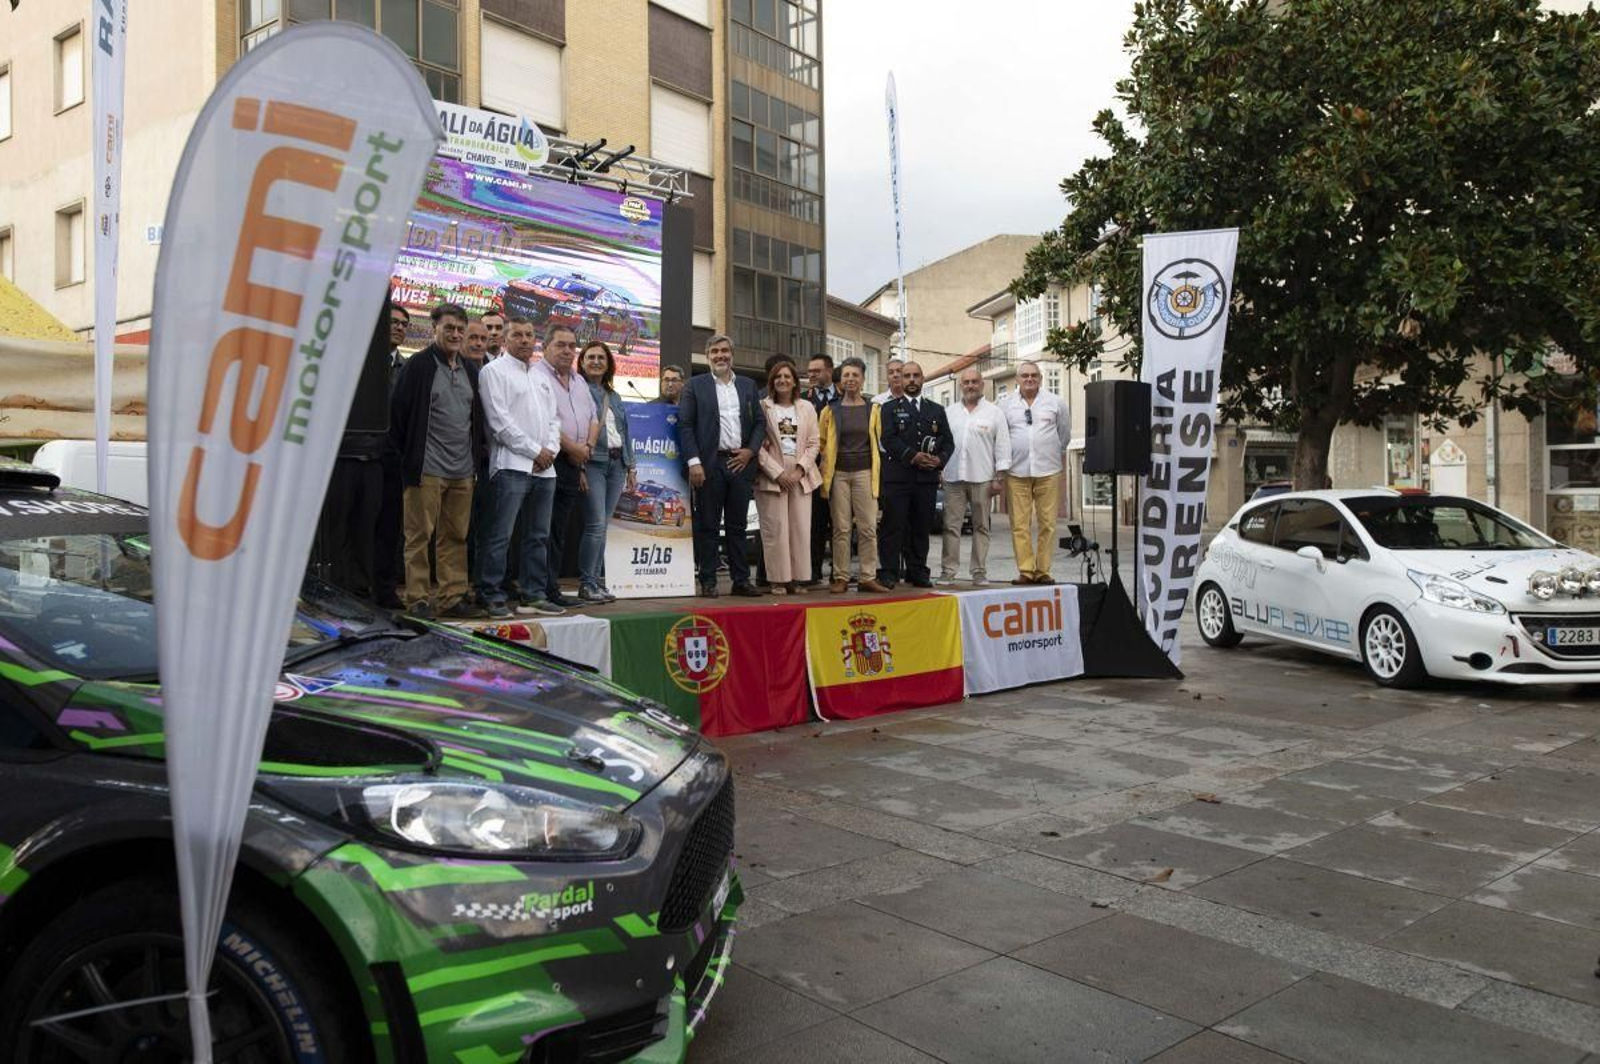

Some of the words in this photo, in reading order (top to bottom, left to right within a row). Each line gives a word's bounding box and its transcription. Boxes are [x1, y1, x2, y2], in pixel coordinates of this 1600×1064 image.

[440, 110, 467, 135] ALI
[469, 120, 483, 134] DA
[483, 116, 534, 150] ÁGUA
[466, 151, 497, 165] CHAVES
[283, 130, 404, 446] motorsport
[391, 286, 430, 305] AVES
[177, 96, 358, 562] cami
[631, 543, 673, 567] 15/16
[983, 587, 1063, 639] cami
[1008, 633, 1063, 653] motorsport
[1559, 629, 1594, 644] 2283
[523, 880, 596, 914] Pardal
[552, 899, 594, 921] sport
[222, 932, 318, 1055] MICHELIN
